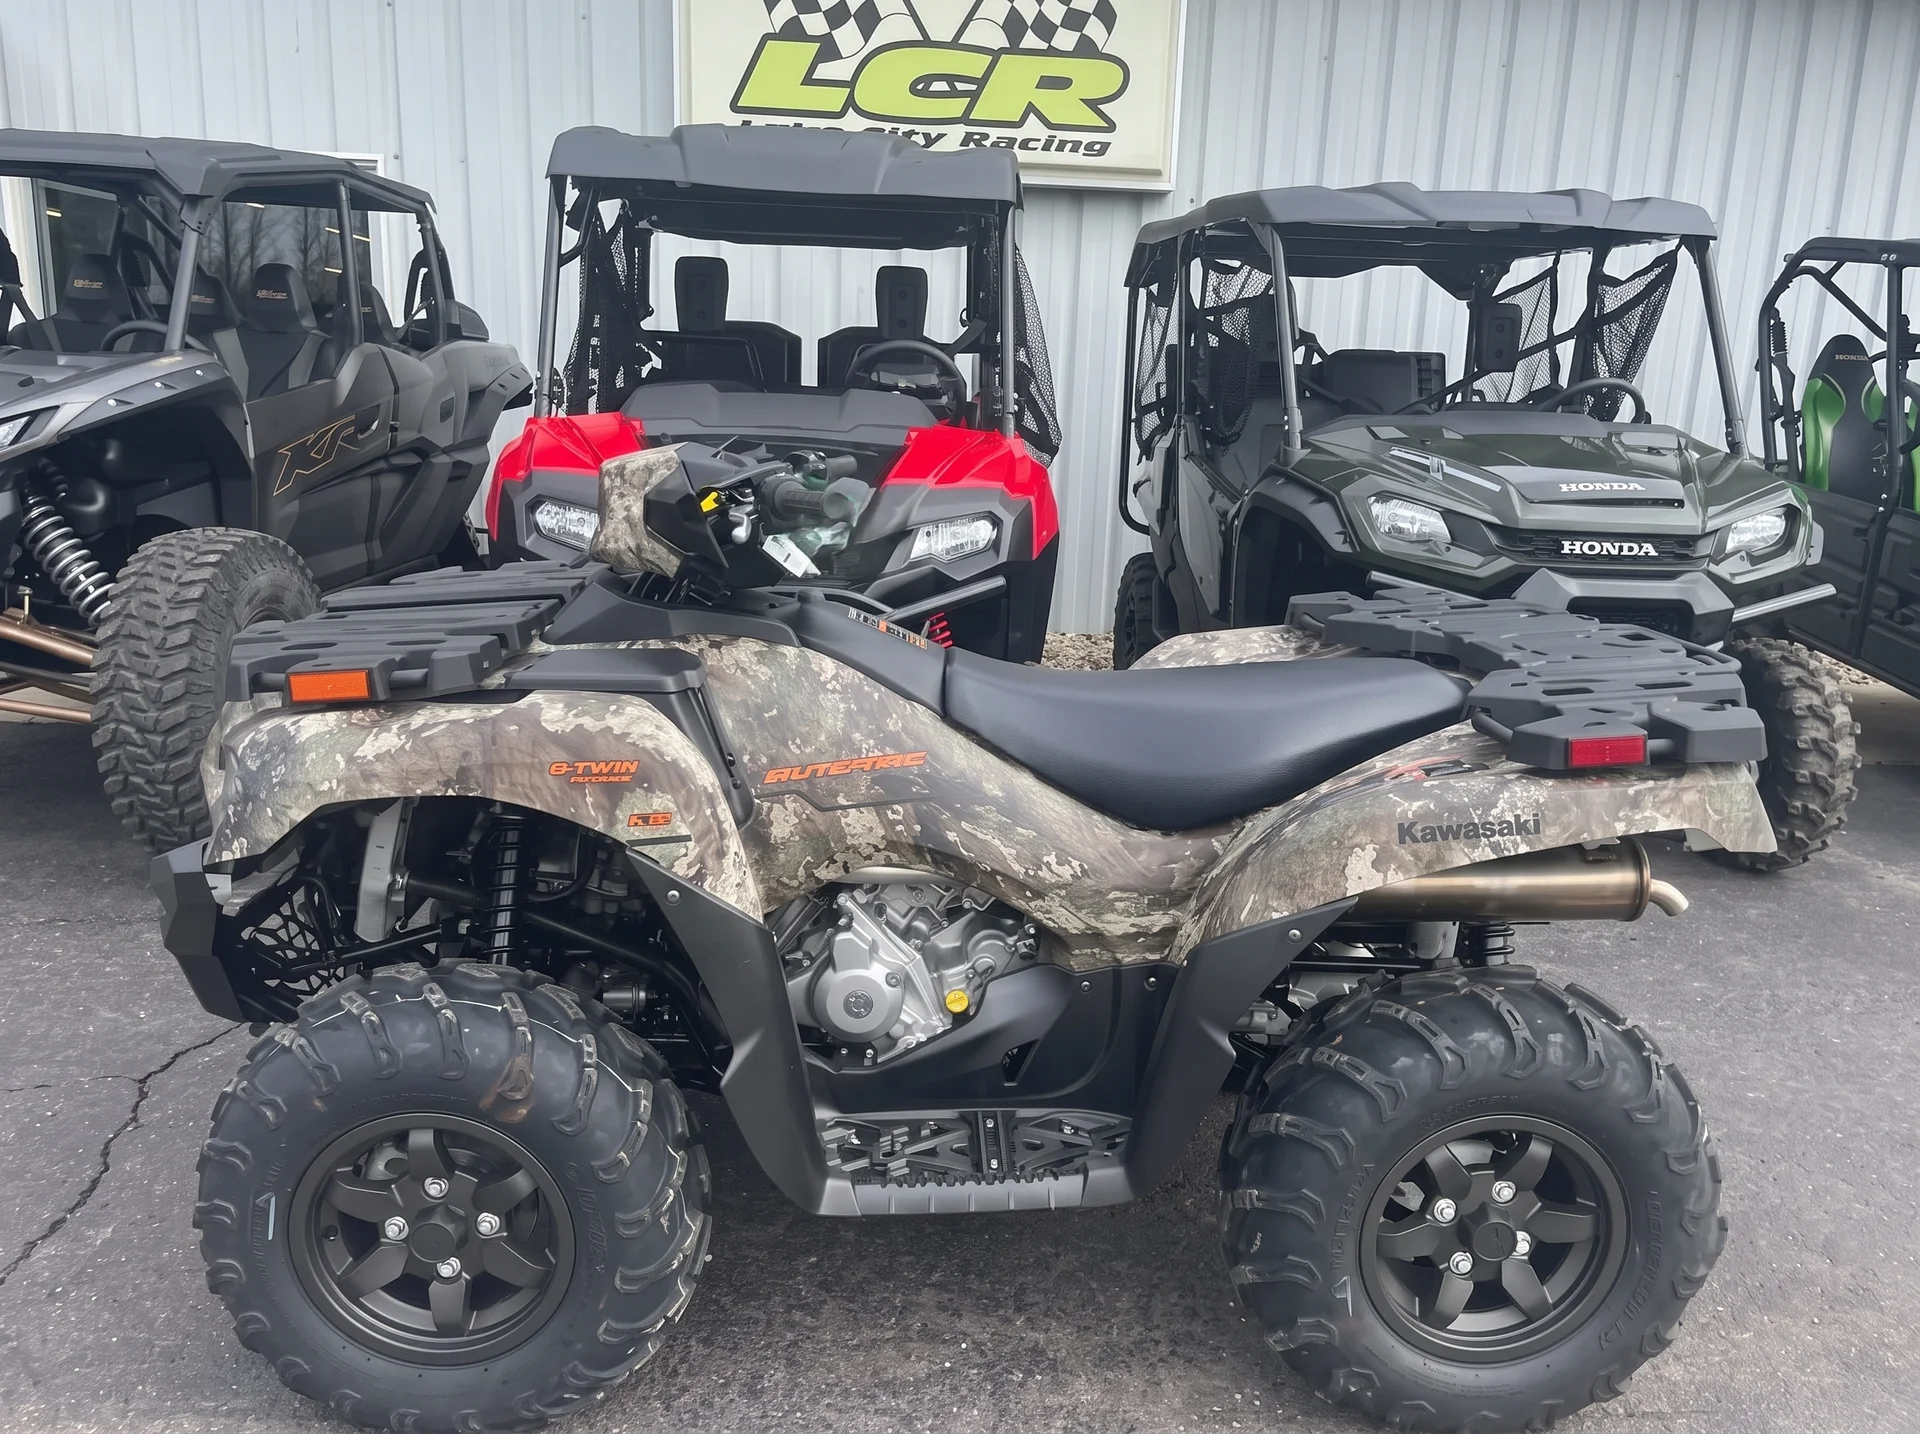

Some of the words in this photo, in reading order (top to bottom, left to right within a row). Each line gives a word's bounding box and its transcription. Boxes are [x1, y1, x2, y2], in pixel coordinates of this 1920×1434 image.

[731, 34, 1130, 132] LCR
[863, 127, 948, 149] ty
[959, 131, 1112, 157] Racing
[1559, 482, 1646, 492] HONDA
[1560, 540, 1659, 556] HONDA
[1397, 812, 1541, 845] Kawasaki
